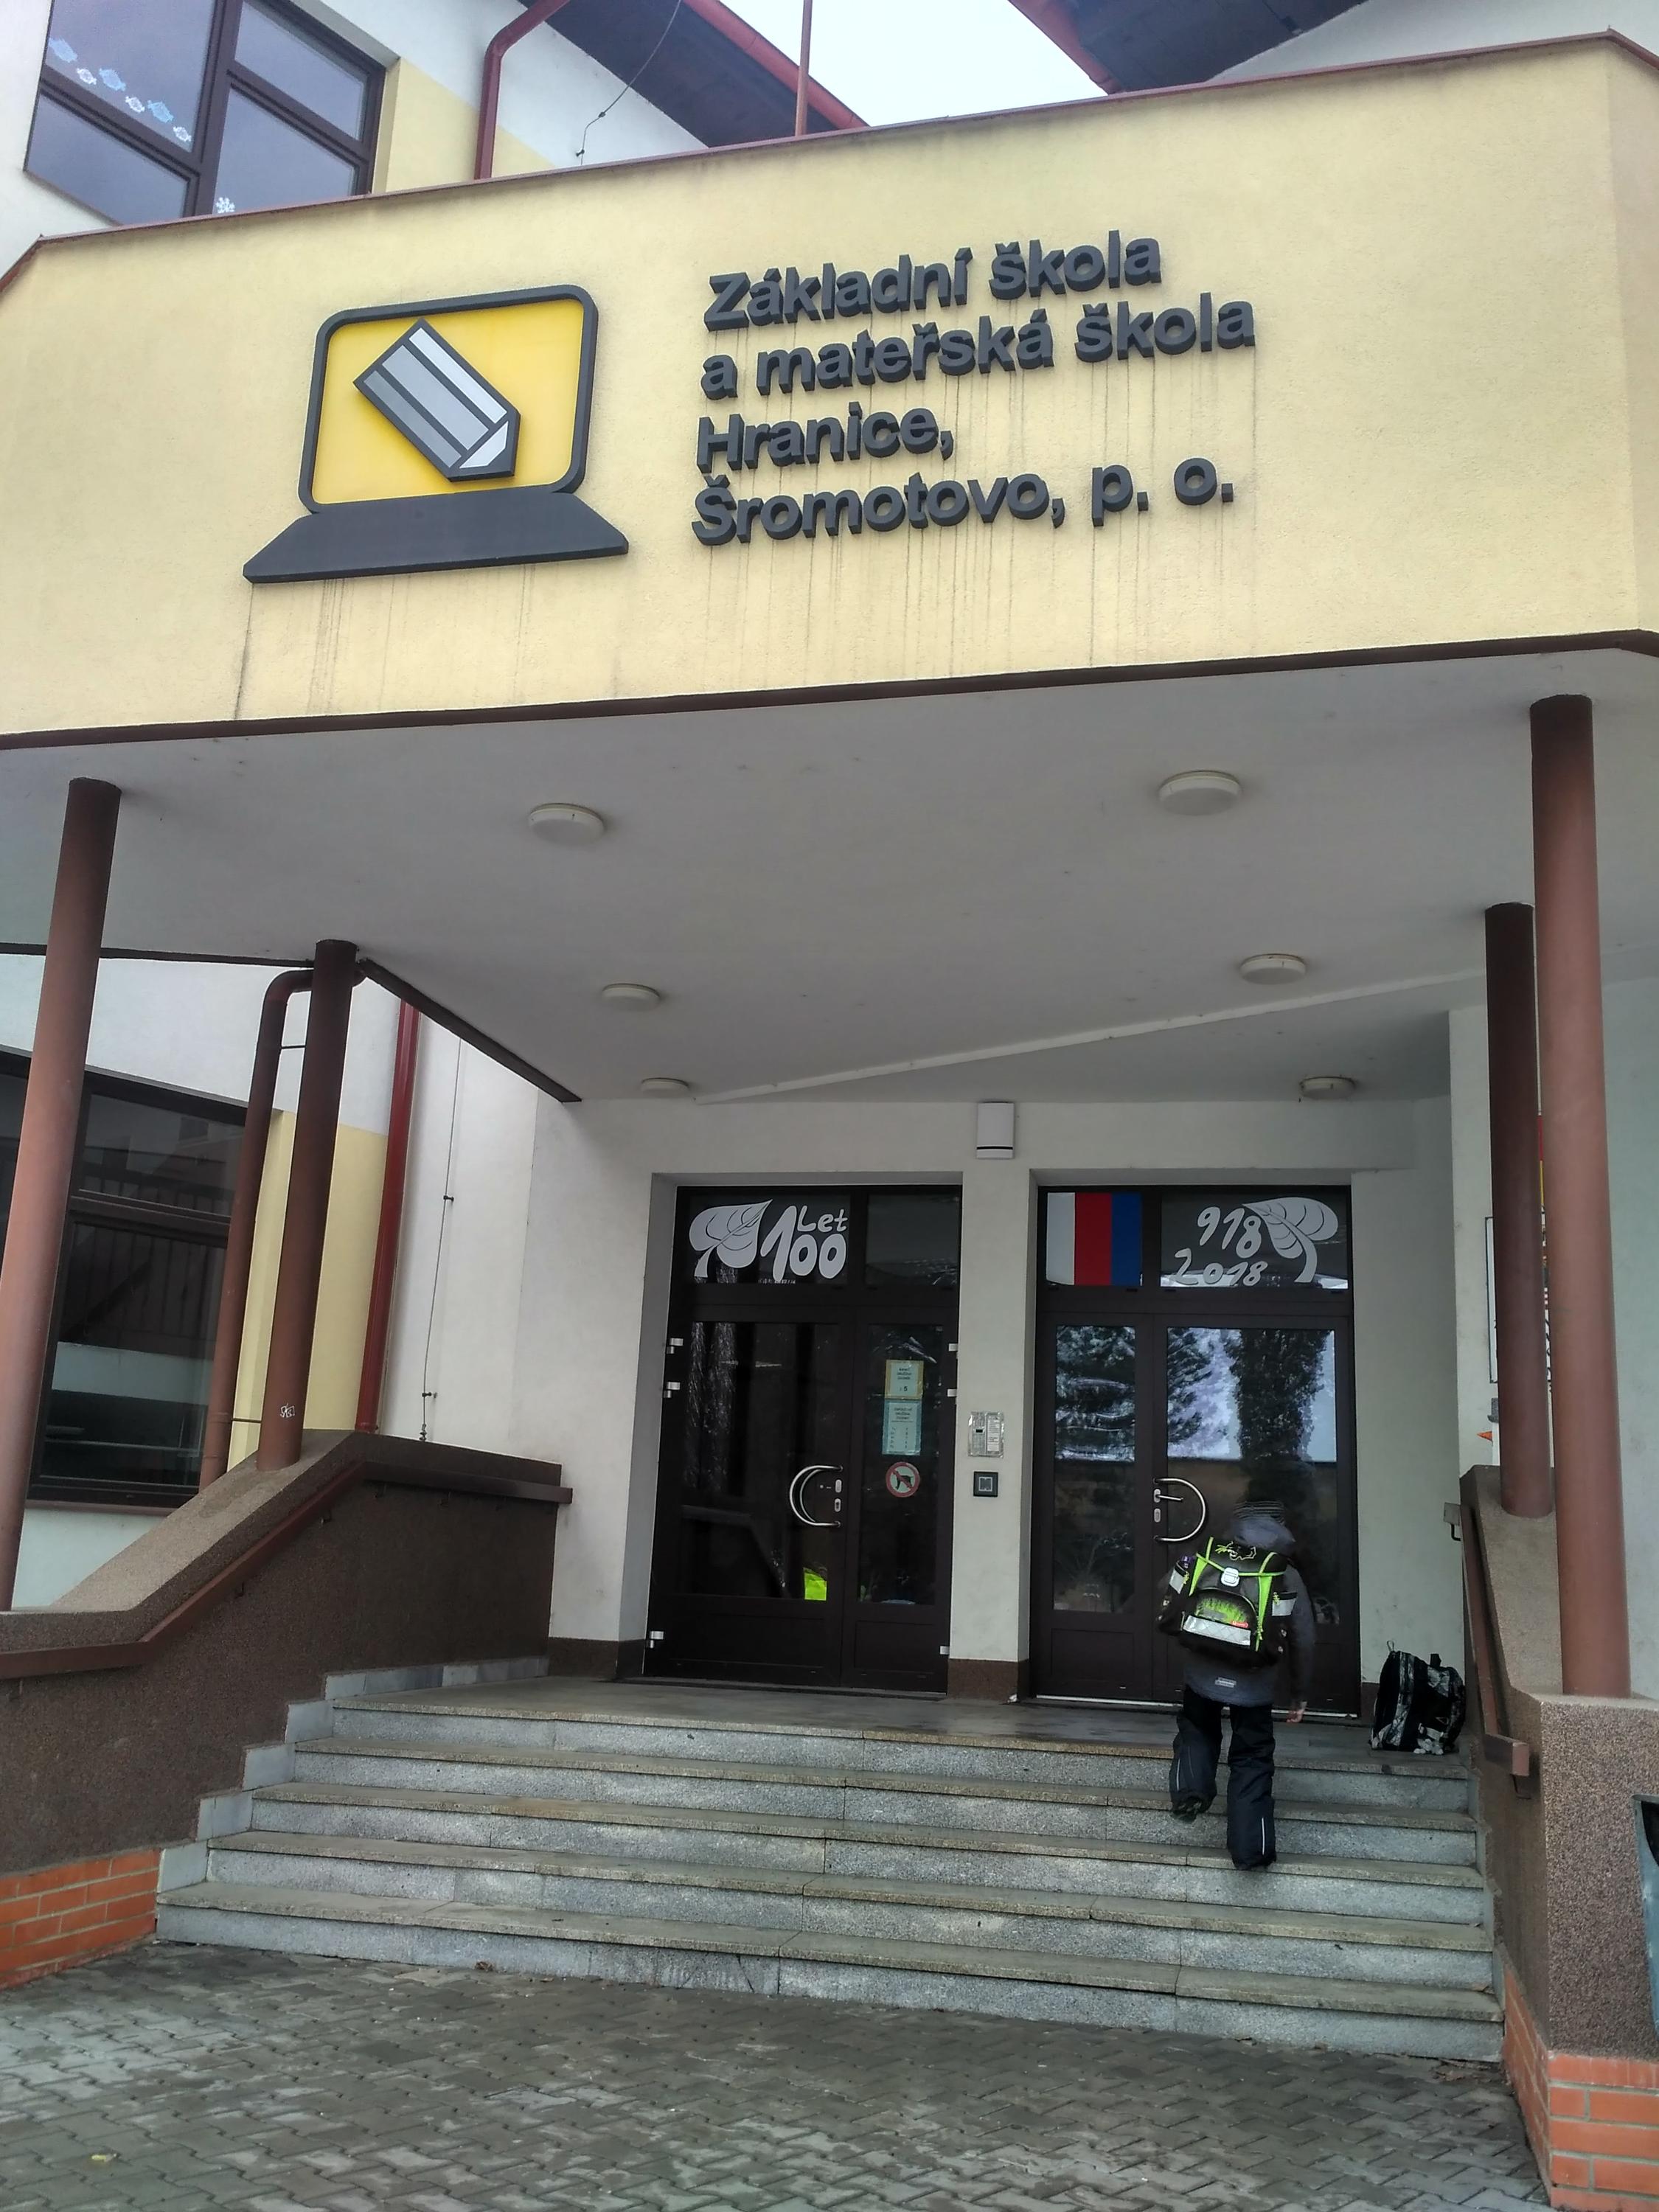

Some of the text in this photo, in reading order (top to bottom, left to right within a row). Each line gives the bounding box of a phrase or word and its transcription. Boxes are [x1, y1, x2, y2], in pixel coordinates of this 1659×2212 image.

[703, 229, 1162, 333] Základní škola
[700, 292, 1256, 401] a mateřská škola
[696, 401, 954, 474] Hranice,
[691, 456, 1234, 546] Šromotovo, p. o.
[760, 1205, 847, 1282] 100
[796, 1205, 849, 1233] Let
[1197, 1206, 1262, 1259] 918
[1170, 1248, 1269, 1287] 2018
